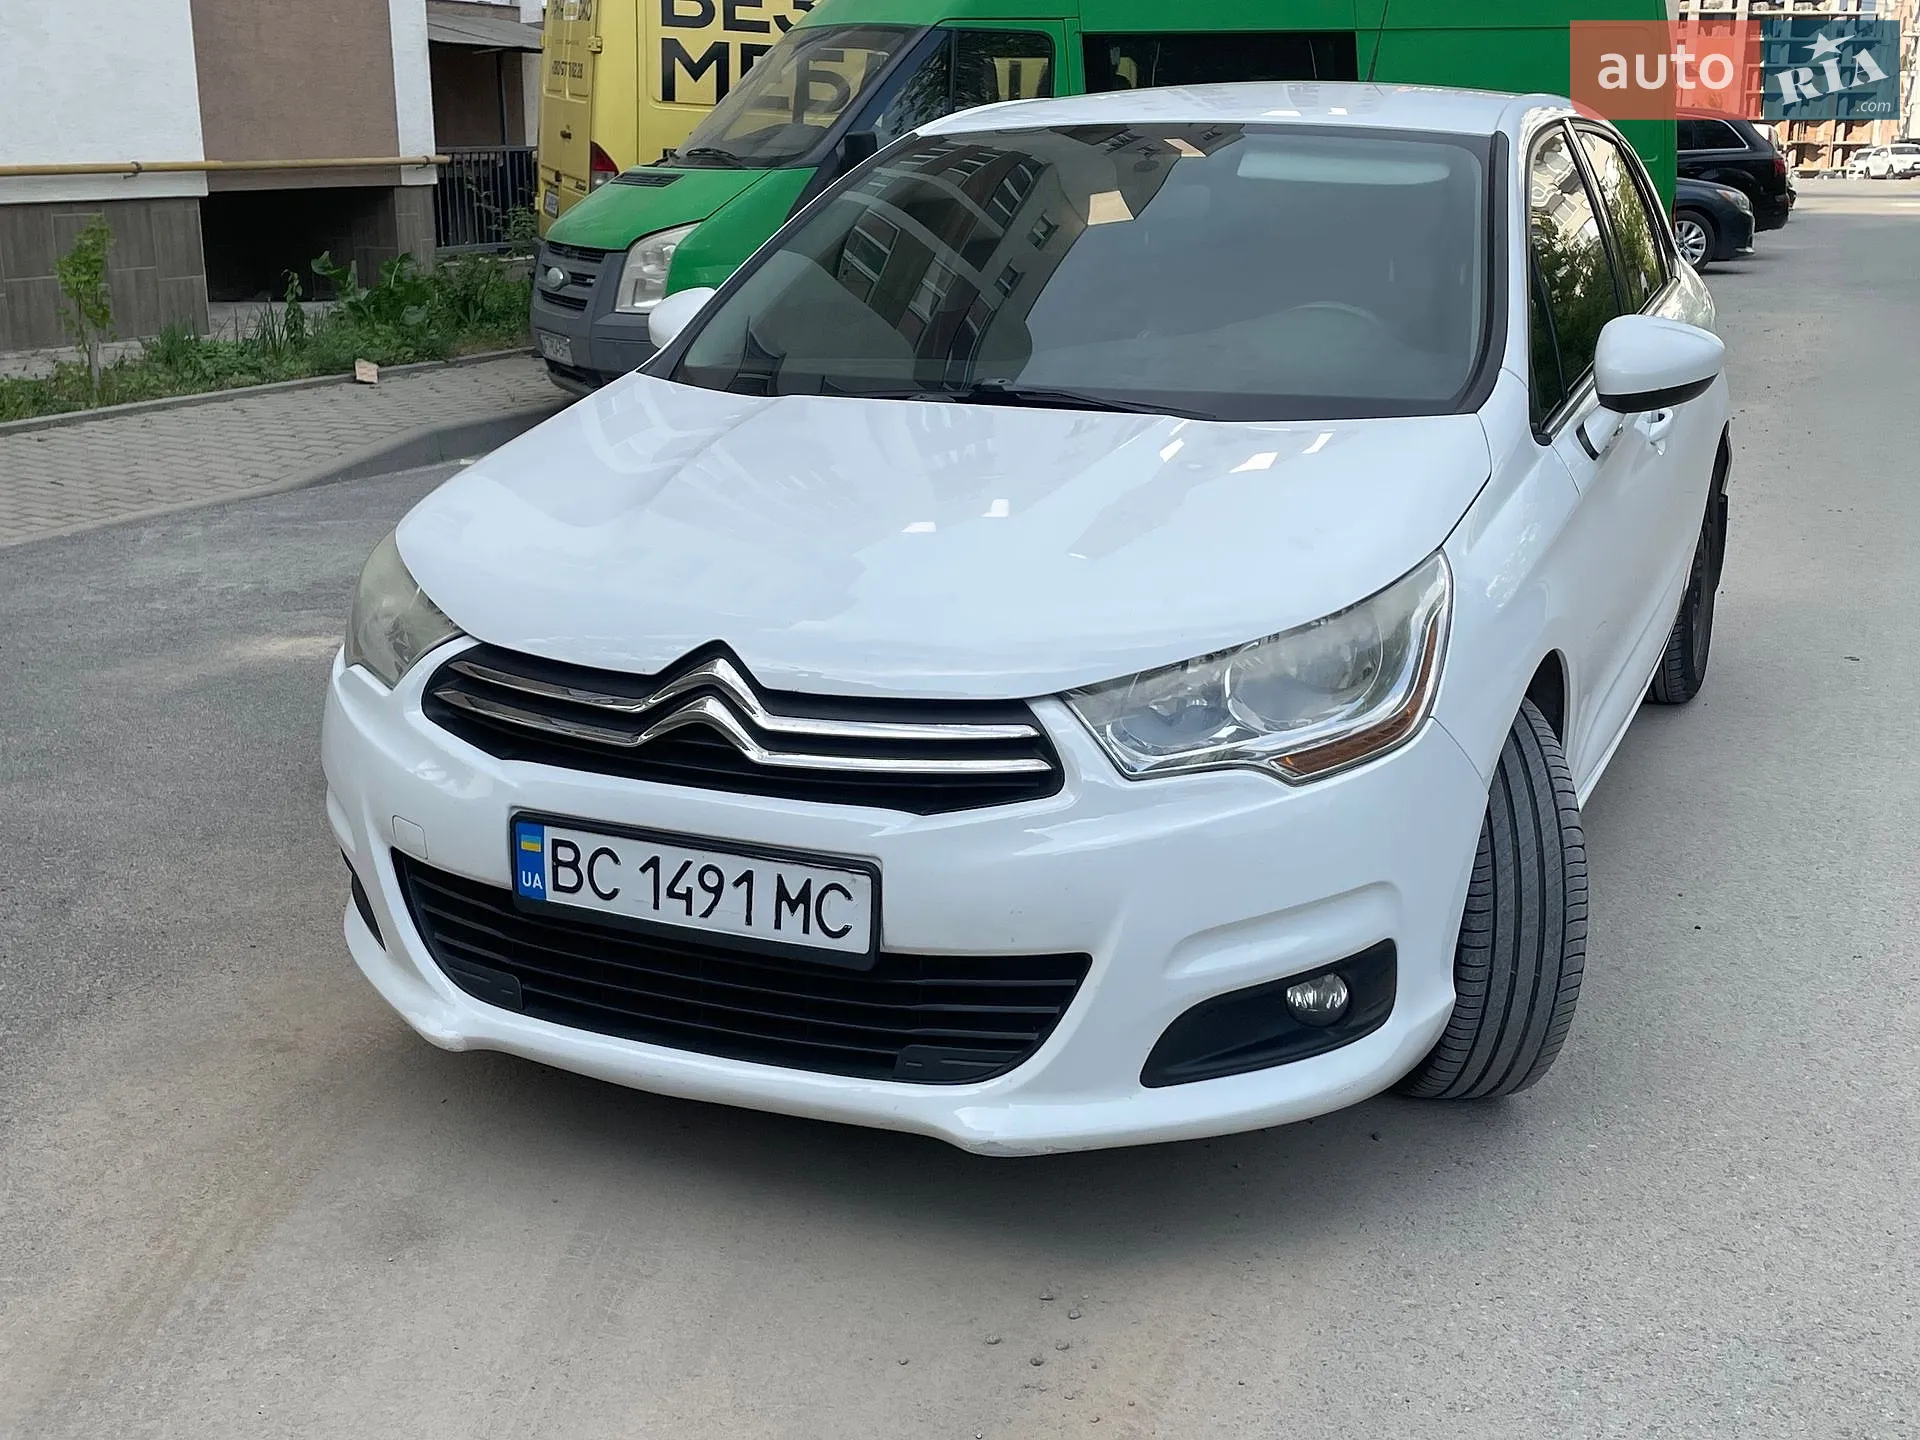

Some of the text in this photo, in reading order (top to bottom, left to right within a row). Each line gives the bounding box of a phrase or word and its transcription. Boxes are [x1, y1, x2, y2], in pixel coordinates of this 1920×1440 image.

[521, 870, 543, 889] UA
[551, 838, 854, 940] BC 1491 MC
